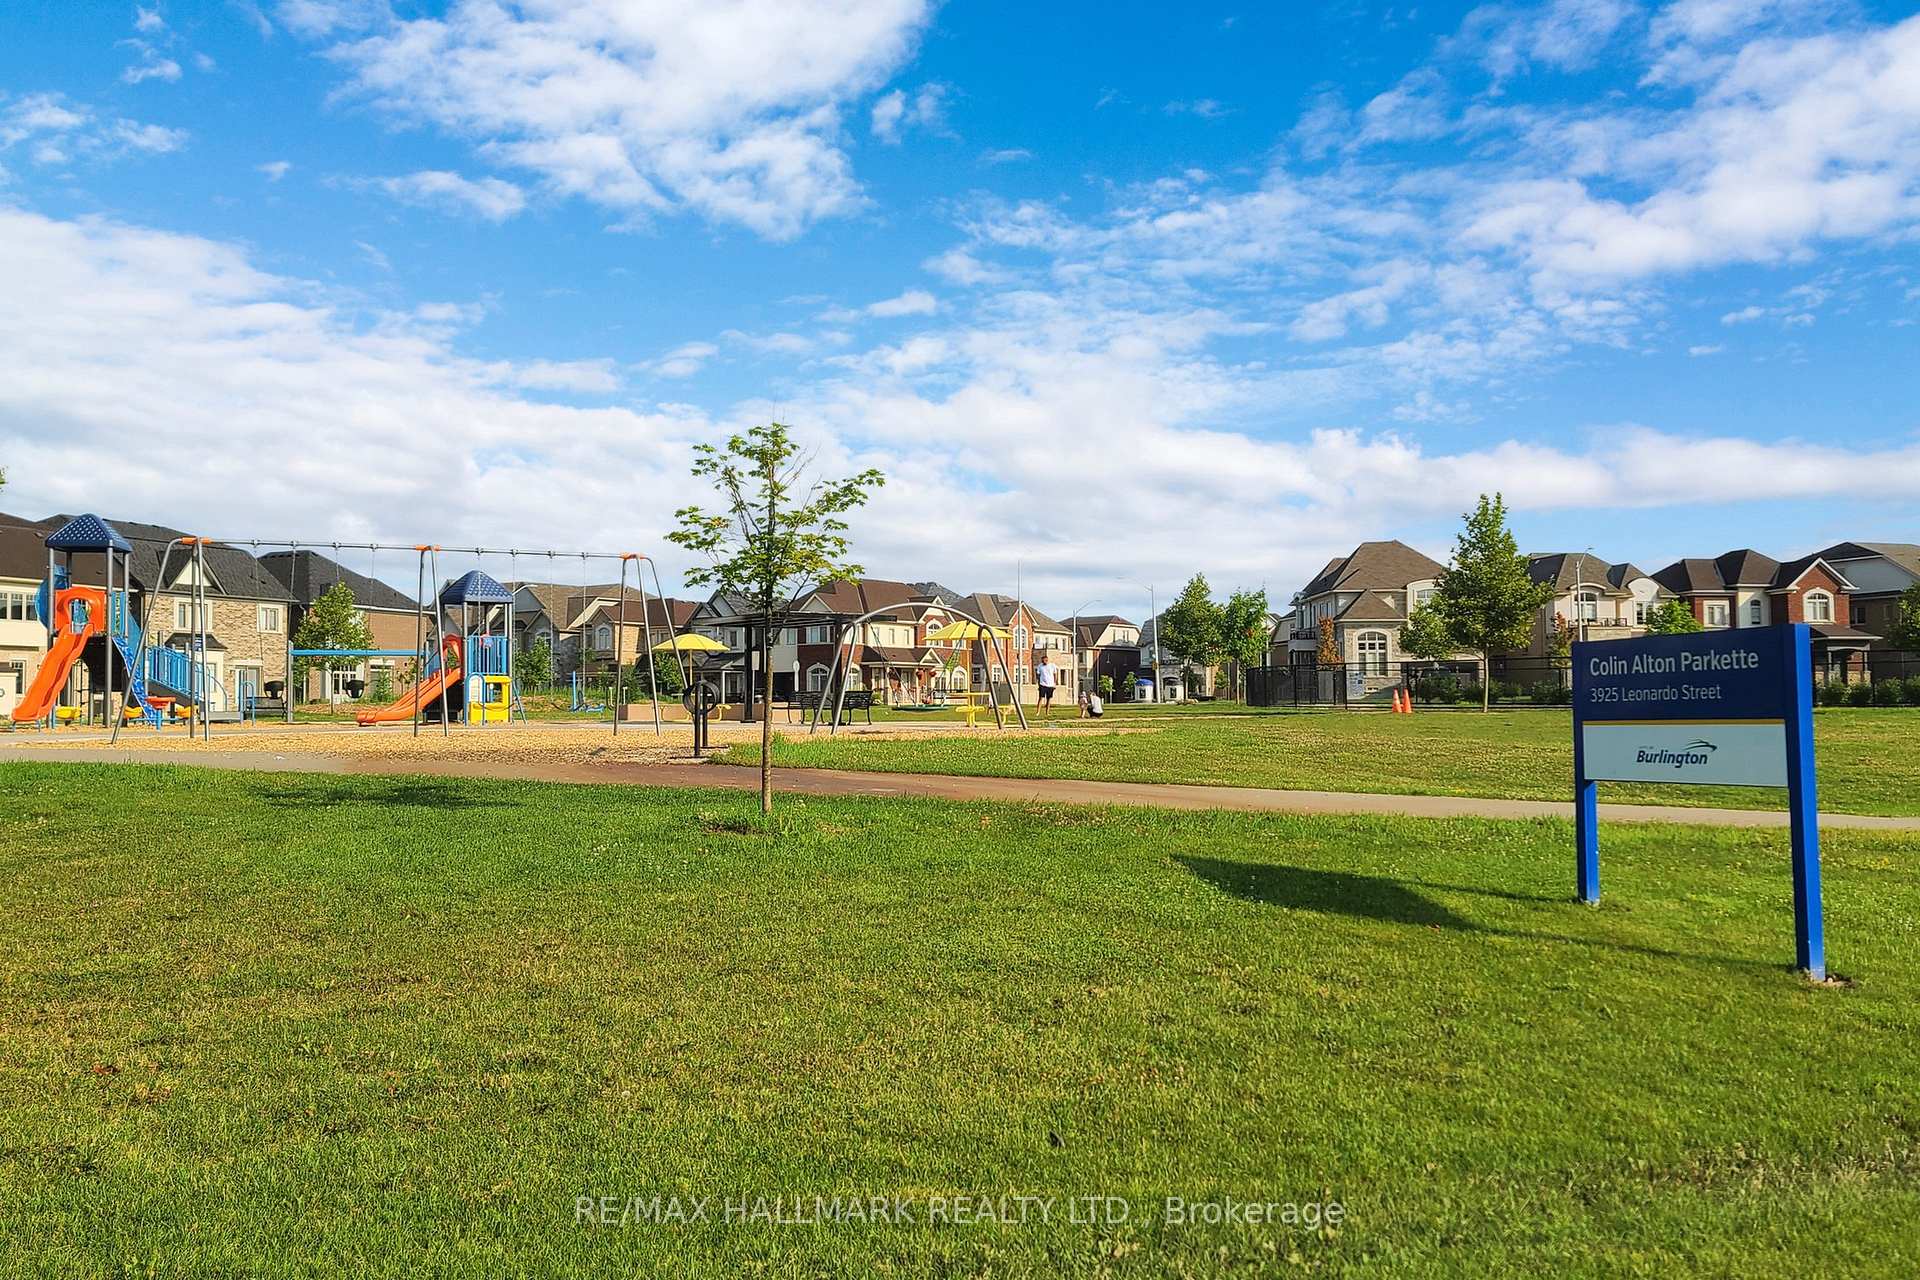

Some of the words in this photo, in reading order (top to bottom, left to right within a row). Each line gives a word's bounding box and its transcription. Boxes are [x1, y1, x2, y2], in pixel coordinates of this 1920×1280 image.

[1590, 655, 1627, 676] Colin
[1632, 653, 1675, 674] Alton
[1681, 649, 1759, 672] Parkette
[1591, 687, 1618, 702] 3925
[1622, 686, 1678, 702] Leonardo
[1682, 684, 1722, 700] Street
[1636, 749, 1708, 768] Burlington
